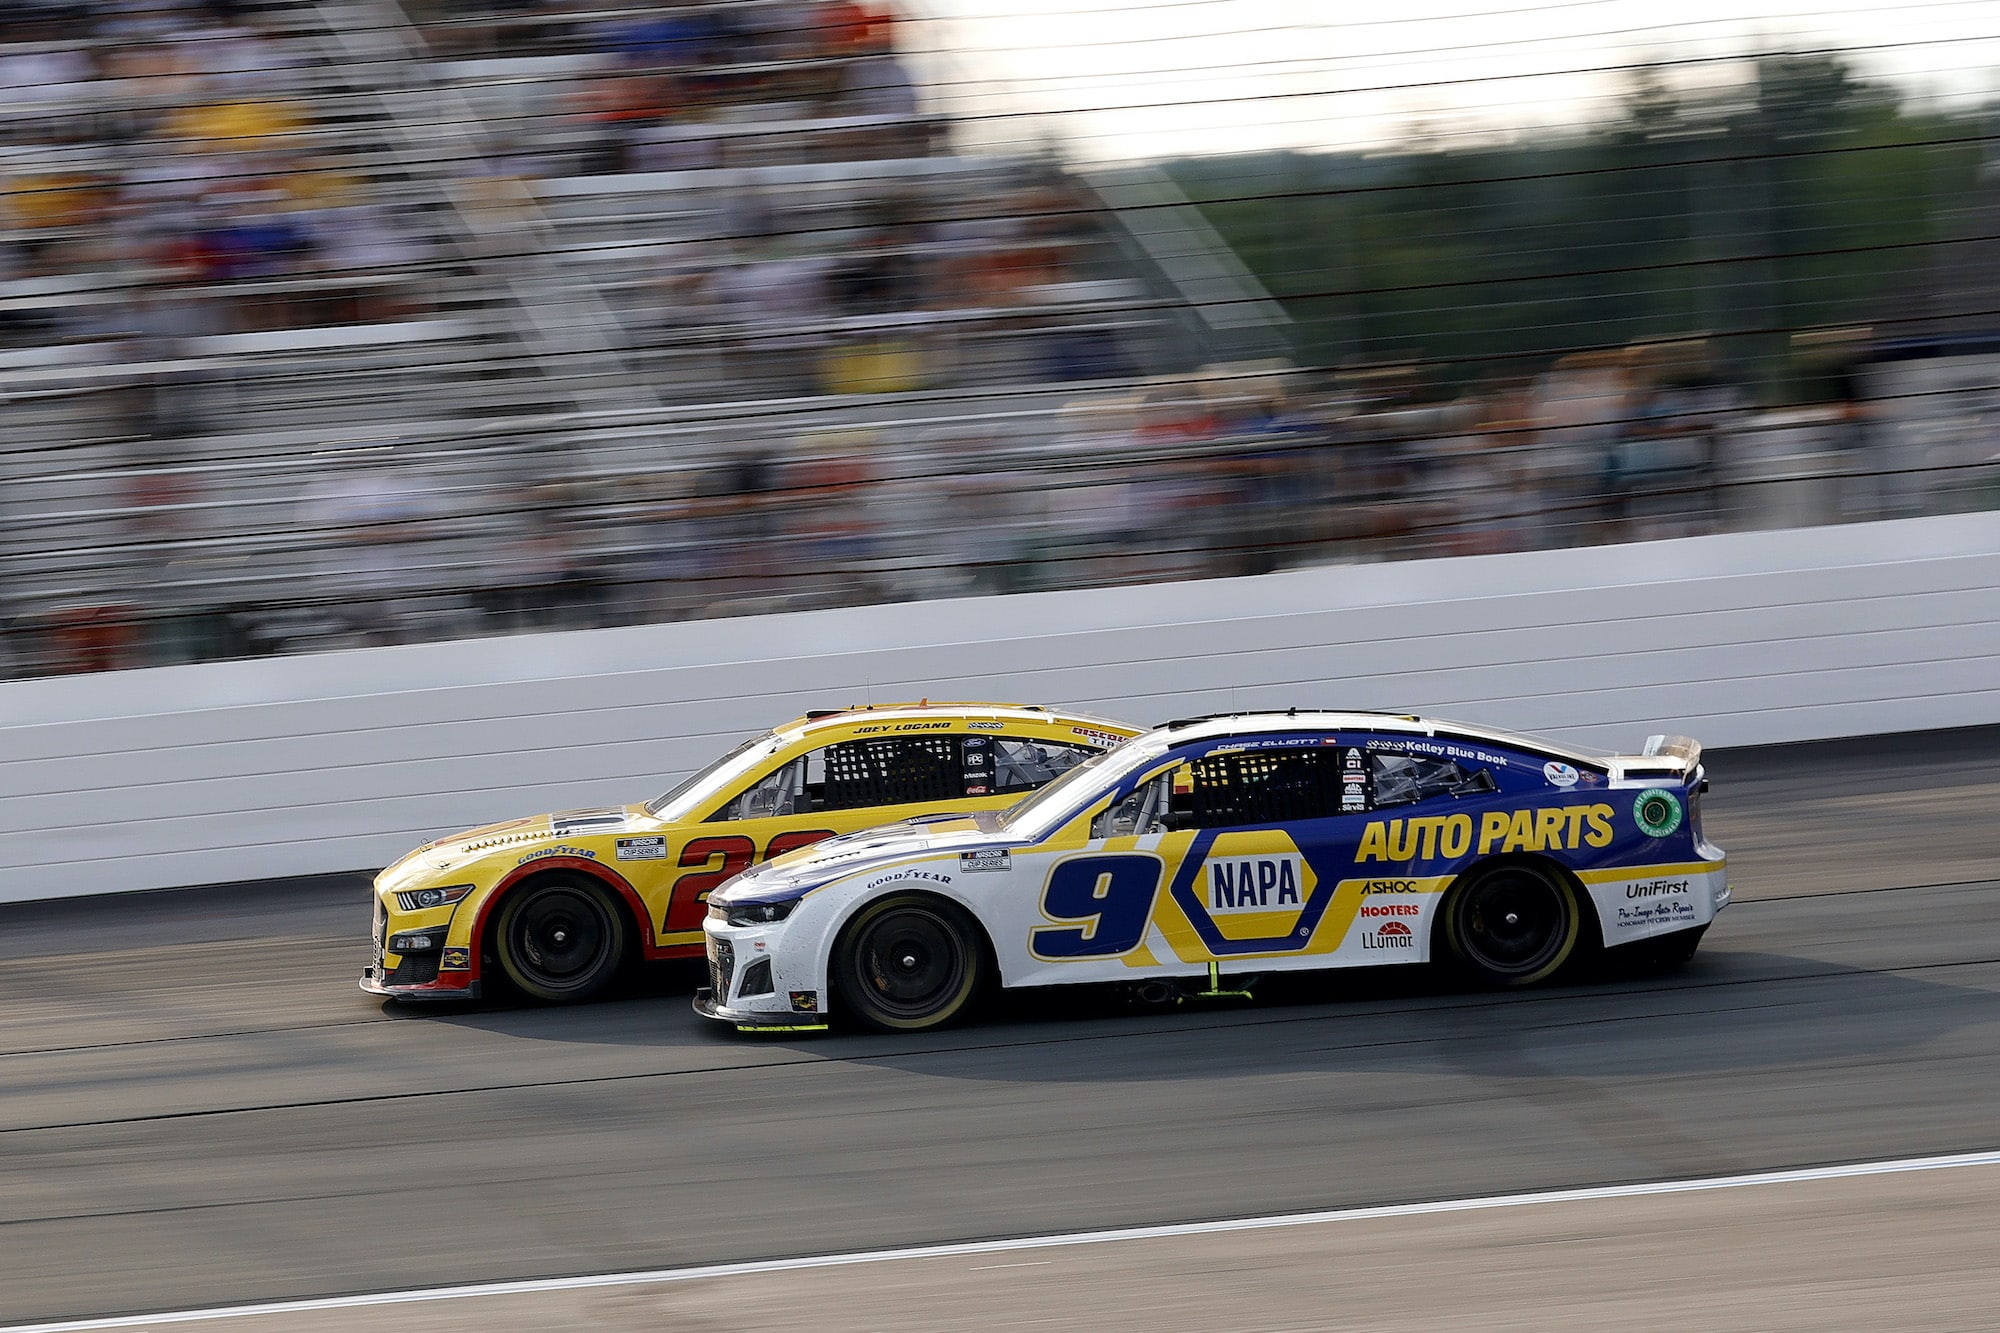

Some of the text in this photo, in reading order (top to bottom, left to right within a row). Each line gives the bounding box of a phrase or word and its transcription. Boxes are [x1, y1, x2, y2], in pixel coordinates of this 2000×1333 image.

[852, 722, 952, 734] JOEY LOGANO
[1217, 738, 1318, 750] CHASE ELLIOTT
[1405, 741, 1508, 766] Kelley Blue Book
[1354, 803, 1615, 864] AUTO PARTS
[517, 844, 596, 865] GOODYEAR
[866, 868, 952, 889] GOODYEAR
[1213, 859, 1299, 909] NAPA
[1360, 881, 1417, 895] ASHOC
[1626, 880, 1689, 899] UniFirst
[1028, 851, 1165, 962] 9
[1360, 905, 1419, 918] HOOTERS
[1362, 932, 1414, 949] LLumar
